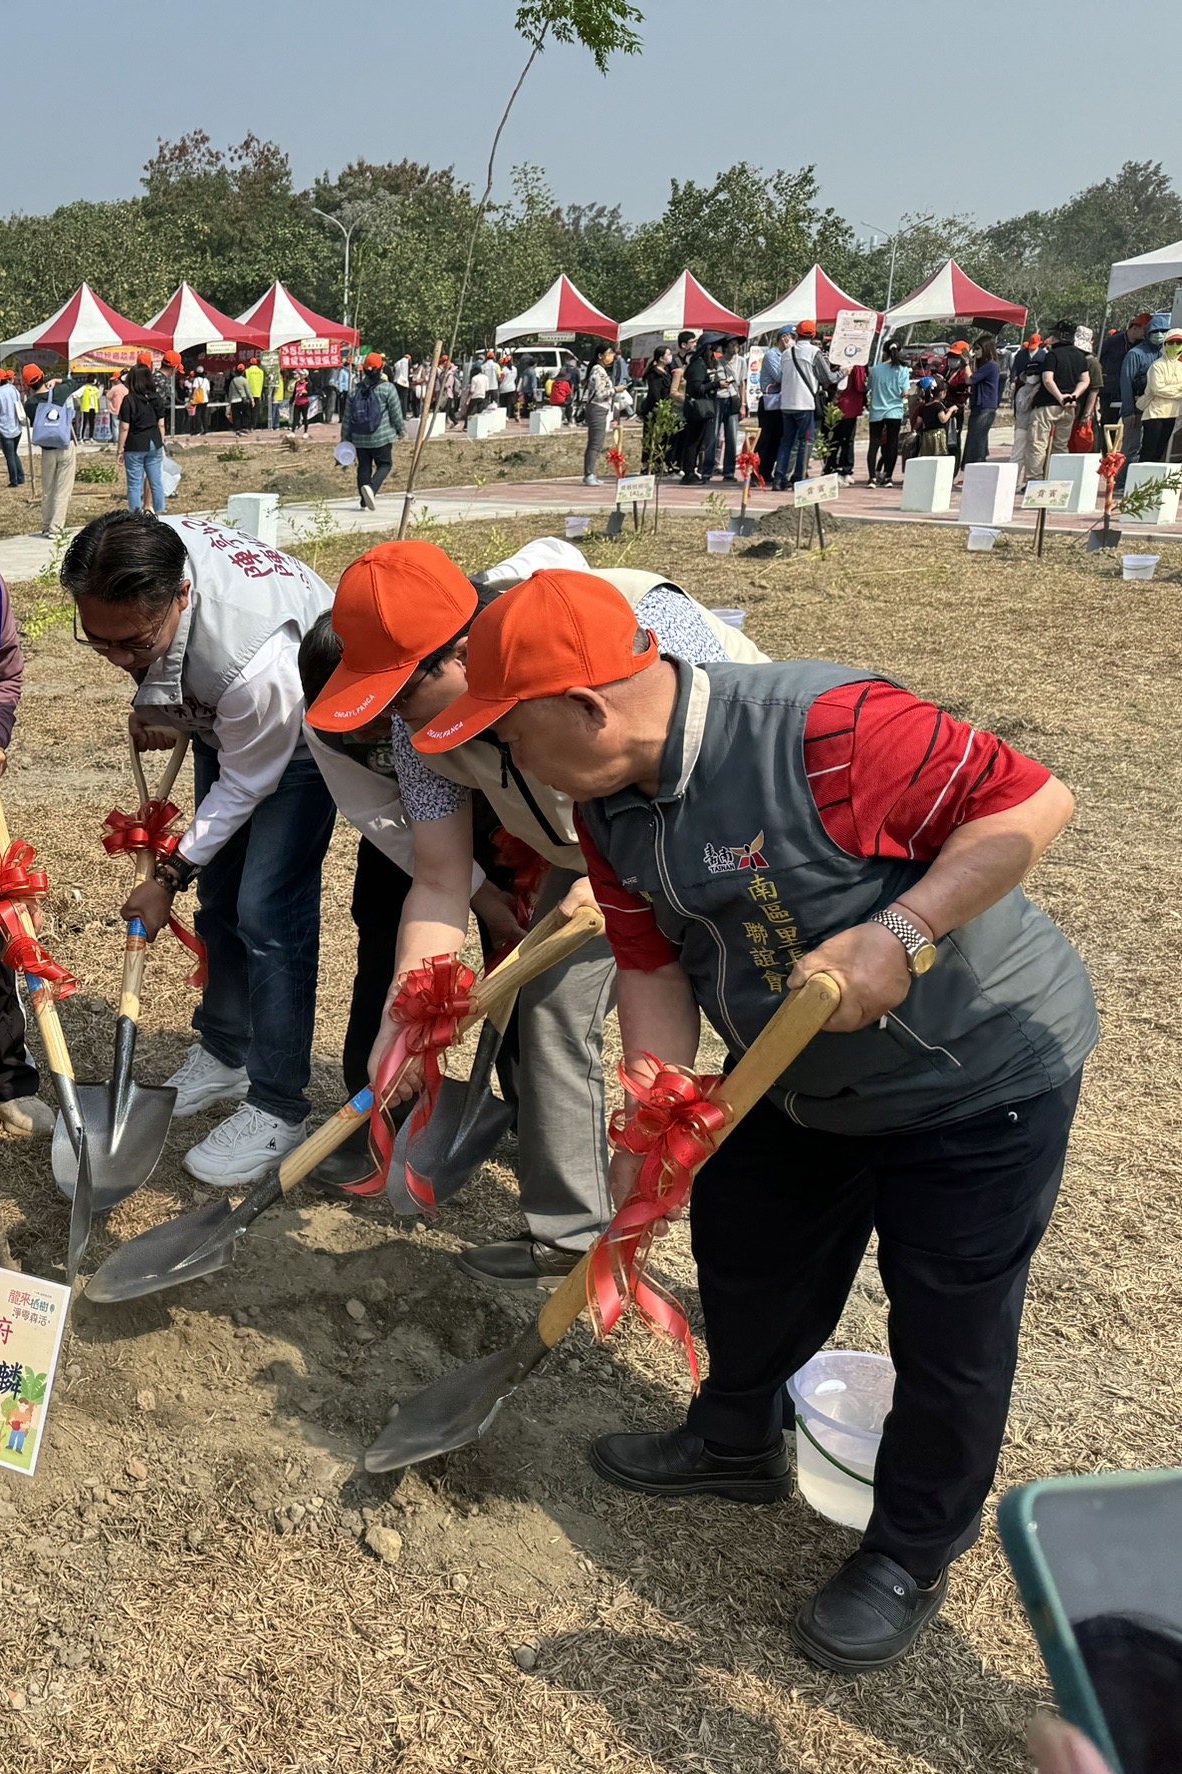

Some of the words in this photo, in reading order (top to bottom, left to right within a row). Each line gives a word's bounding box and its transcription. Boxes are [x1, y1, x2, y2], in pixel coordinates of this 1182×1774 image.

[709, 863, 735, 874] TAINAN
[742, 922, 788, 993] 聯誼會
